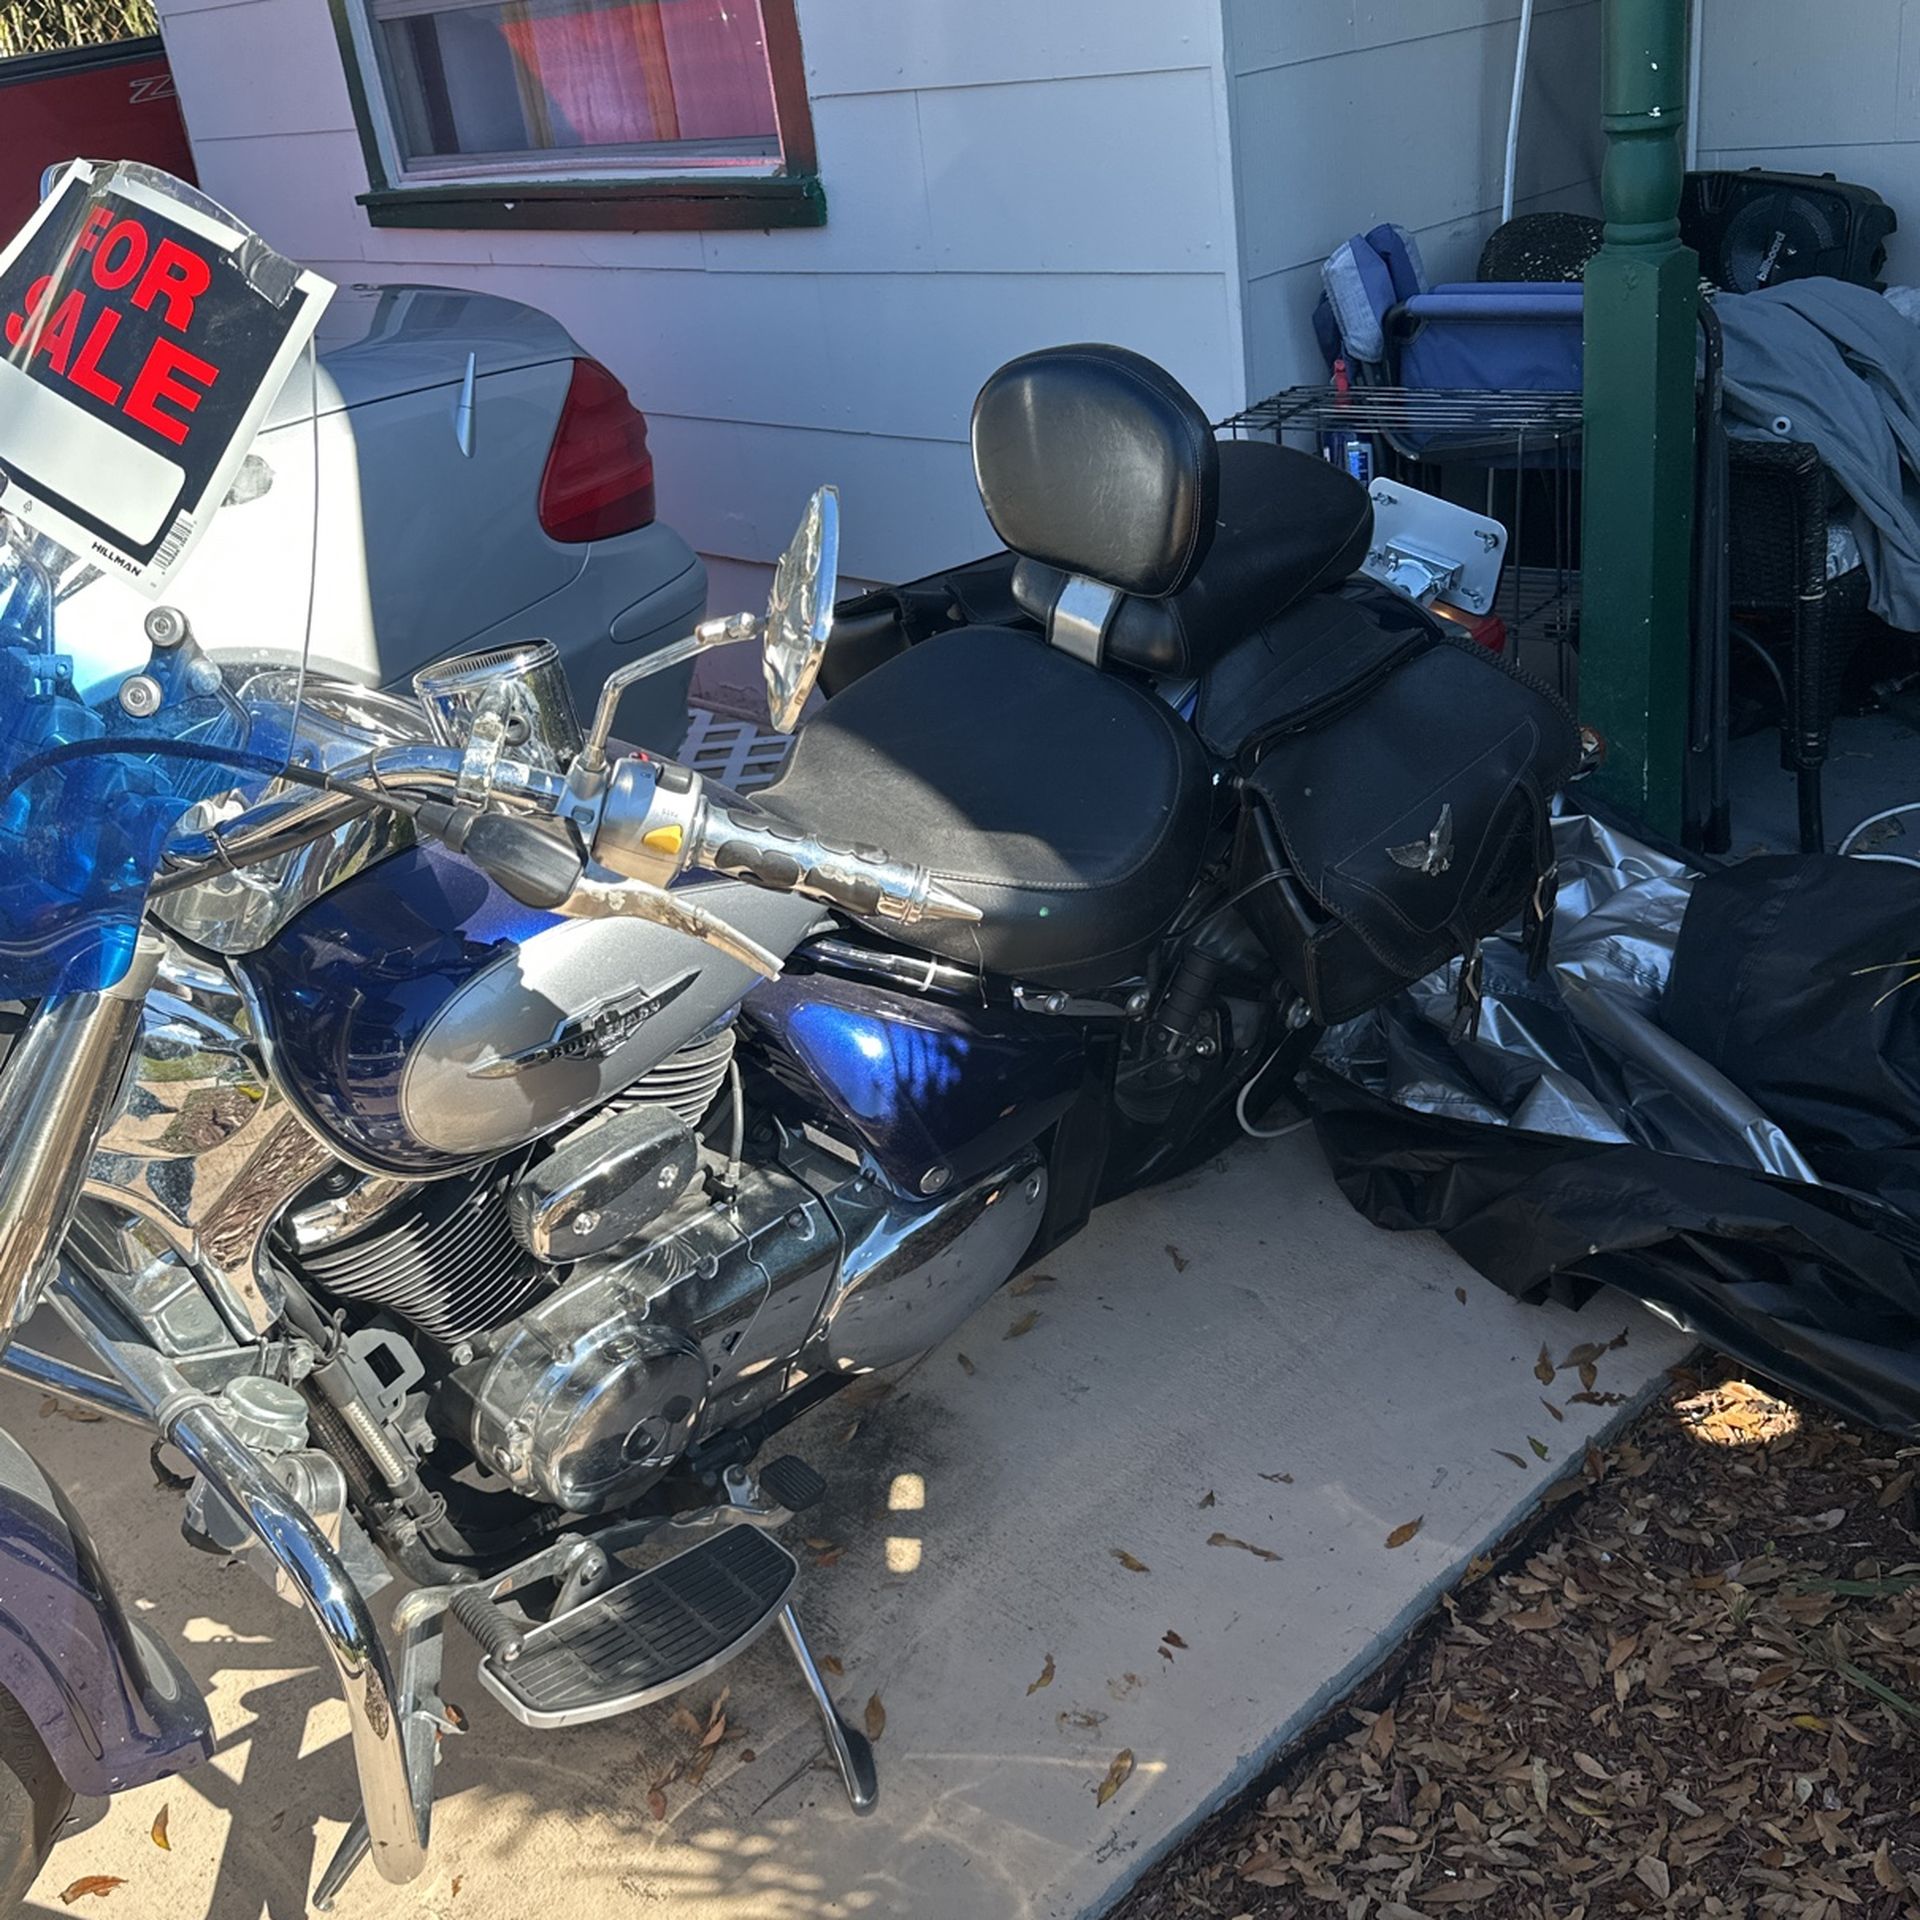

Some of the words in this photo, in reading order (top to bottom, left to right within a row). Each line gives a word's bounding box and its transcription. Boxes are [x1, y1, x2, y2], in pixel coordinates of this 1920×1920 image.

[66, 204, 211, 333] FOR
[1756, 230, 1786, 281] billboard
[5, 275, 219, 446] SALE
[91, 541, 142, 577] HILLMAN
